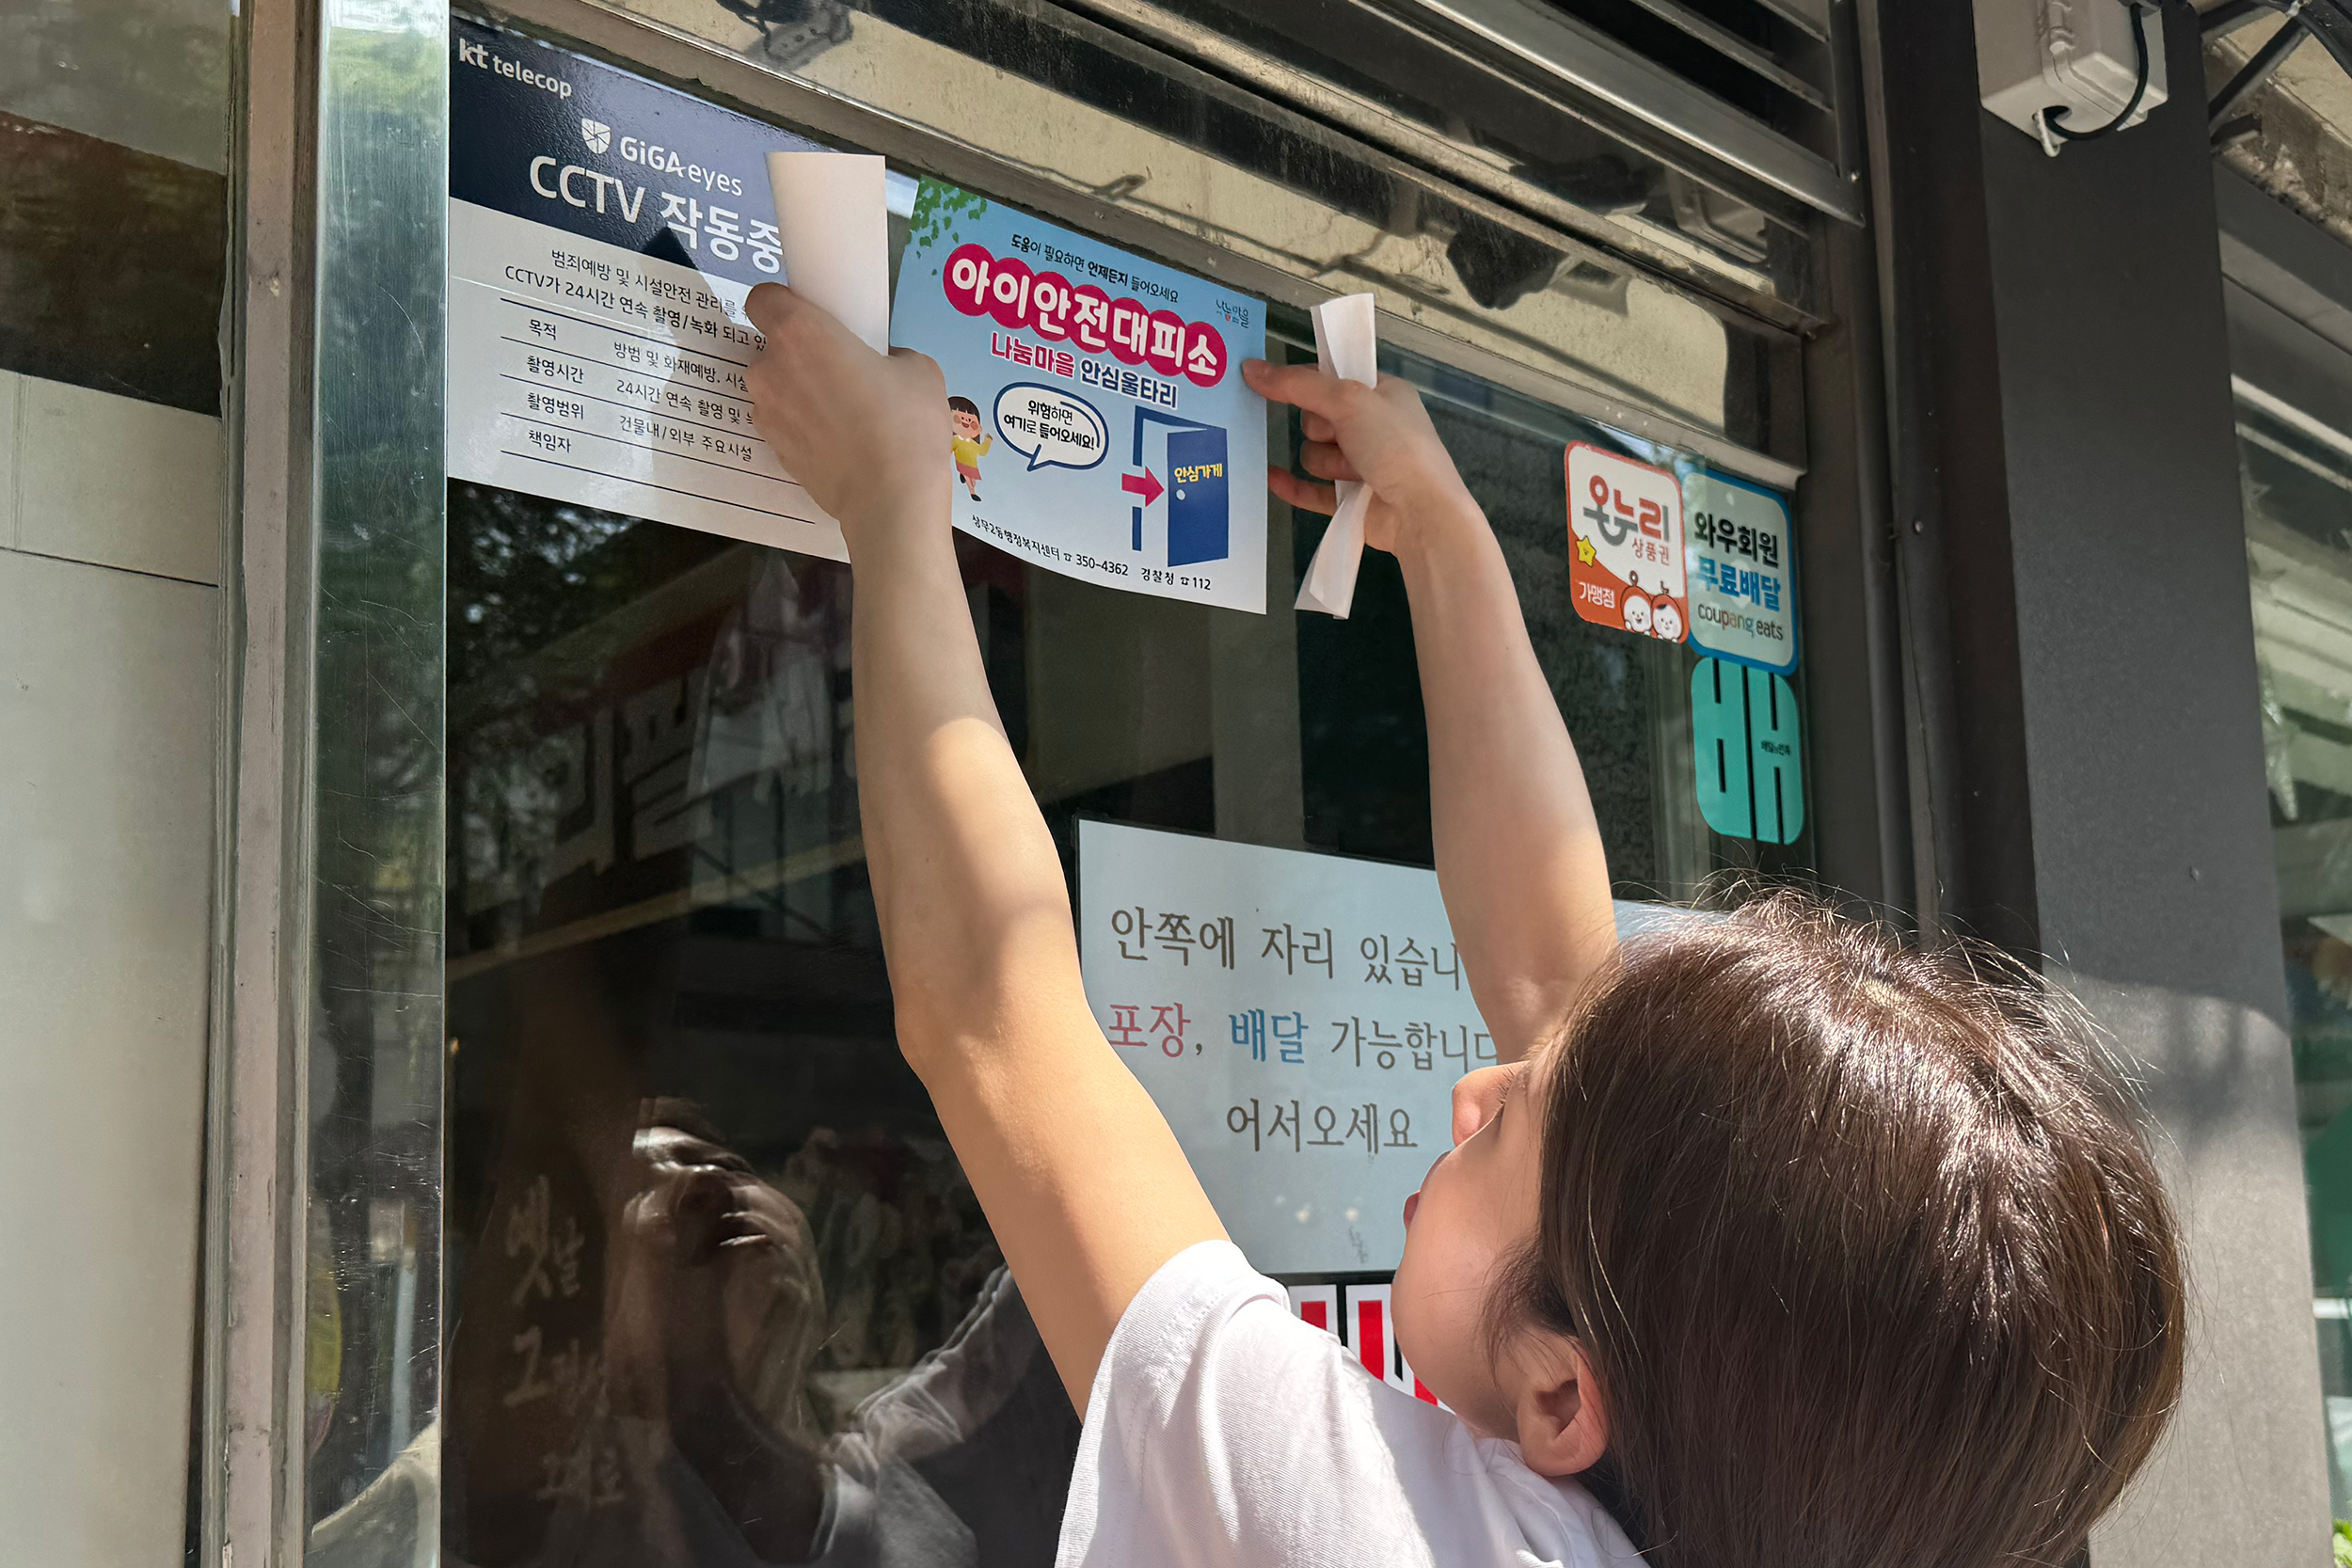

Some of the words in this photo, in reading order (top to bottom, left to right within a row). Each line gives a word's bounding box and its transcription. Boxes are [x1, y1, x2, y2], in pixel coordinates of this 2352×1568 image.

[459, 38, 488, 70] kt
[494, 55, 572, 99] telecop
[530, 155, 645, 224] CCTV
[660, 191, 783, 275] 작동중
[551, 249, 612, 279] 범죄예방
[616, 268, 630, 288] 및
[635, 274, 691, 305] 시설안전
[696, 291, 737, 318] 관리를
[1011, 233, 1041, 257] 도움이
[1043, 245, 1085, 273] 필요하면
[1088, 261, 1128, 287] 언제든지
[1131, 276, 1179, 304] 들어오세요
[505, 265, 562, 294] CCTV가
[565, 281, 614, 310] 24시간
[619, 297, 649, 319] 연속
[653, 305, 718, 339] 촬영/녹화
[723, 325, 750, 346] 되고
[951, 258, 1217, 376] 아이안전대피소
[529, 319, 558, 341] 목적
[527, 356, 584, 384] 촬영시간
[613, 341, 641, 363] 방범
[646, 350, 660, 369] 및
[991, 332, 1075, 377] 나눔마을
[1081, 358, 1178, 409] 안심울타리
[527, 392, 585, 420] 촬영범위
[616, 380, 660, 404] 24시간
[666, 392, 691, 411] 연속
[698, 399, 723, 420] 촬영
[729, 407, 740, 424] 및
[1027, 400, 1073, 426] 위험하면
[529, 429, 572, 453] 책임자
[620, 416, 694, 446] 건물내/외부
[701, 436, 752, 462] 주요시설
[1004, 414, 1037, 435] 여기로
[1039, 422, 1095, 451] 들어오세요!
[1174, 463, 1223, 483] 안심가게
[1631, 538, 1670, 566] 상품권
[1694, 511, 1779, 567] 와우회원
[1075, 554, 1129, 577] 350-4362
[1140, 567, 1175, 585] 경찰청
[1695, 555, 1782, 612] 무료배달
[1579, 580, 1615, 610] 가맹점
[1698, 601, 1754, 639] coupang
[1756, 620, 1784, 641] eats
[1111, 907, 1236, 971] 안쪽에
[1262, 923, 1333, 979] 자리
[1229, 1009, 1309, 1064] 배달
[1227, 1098, 1418, 1154] 어서오세요
